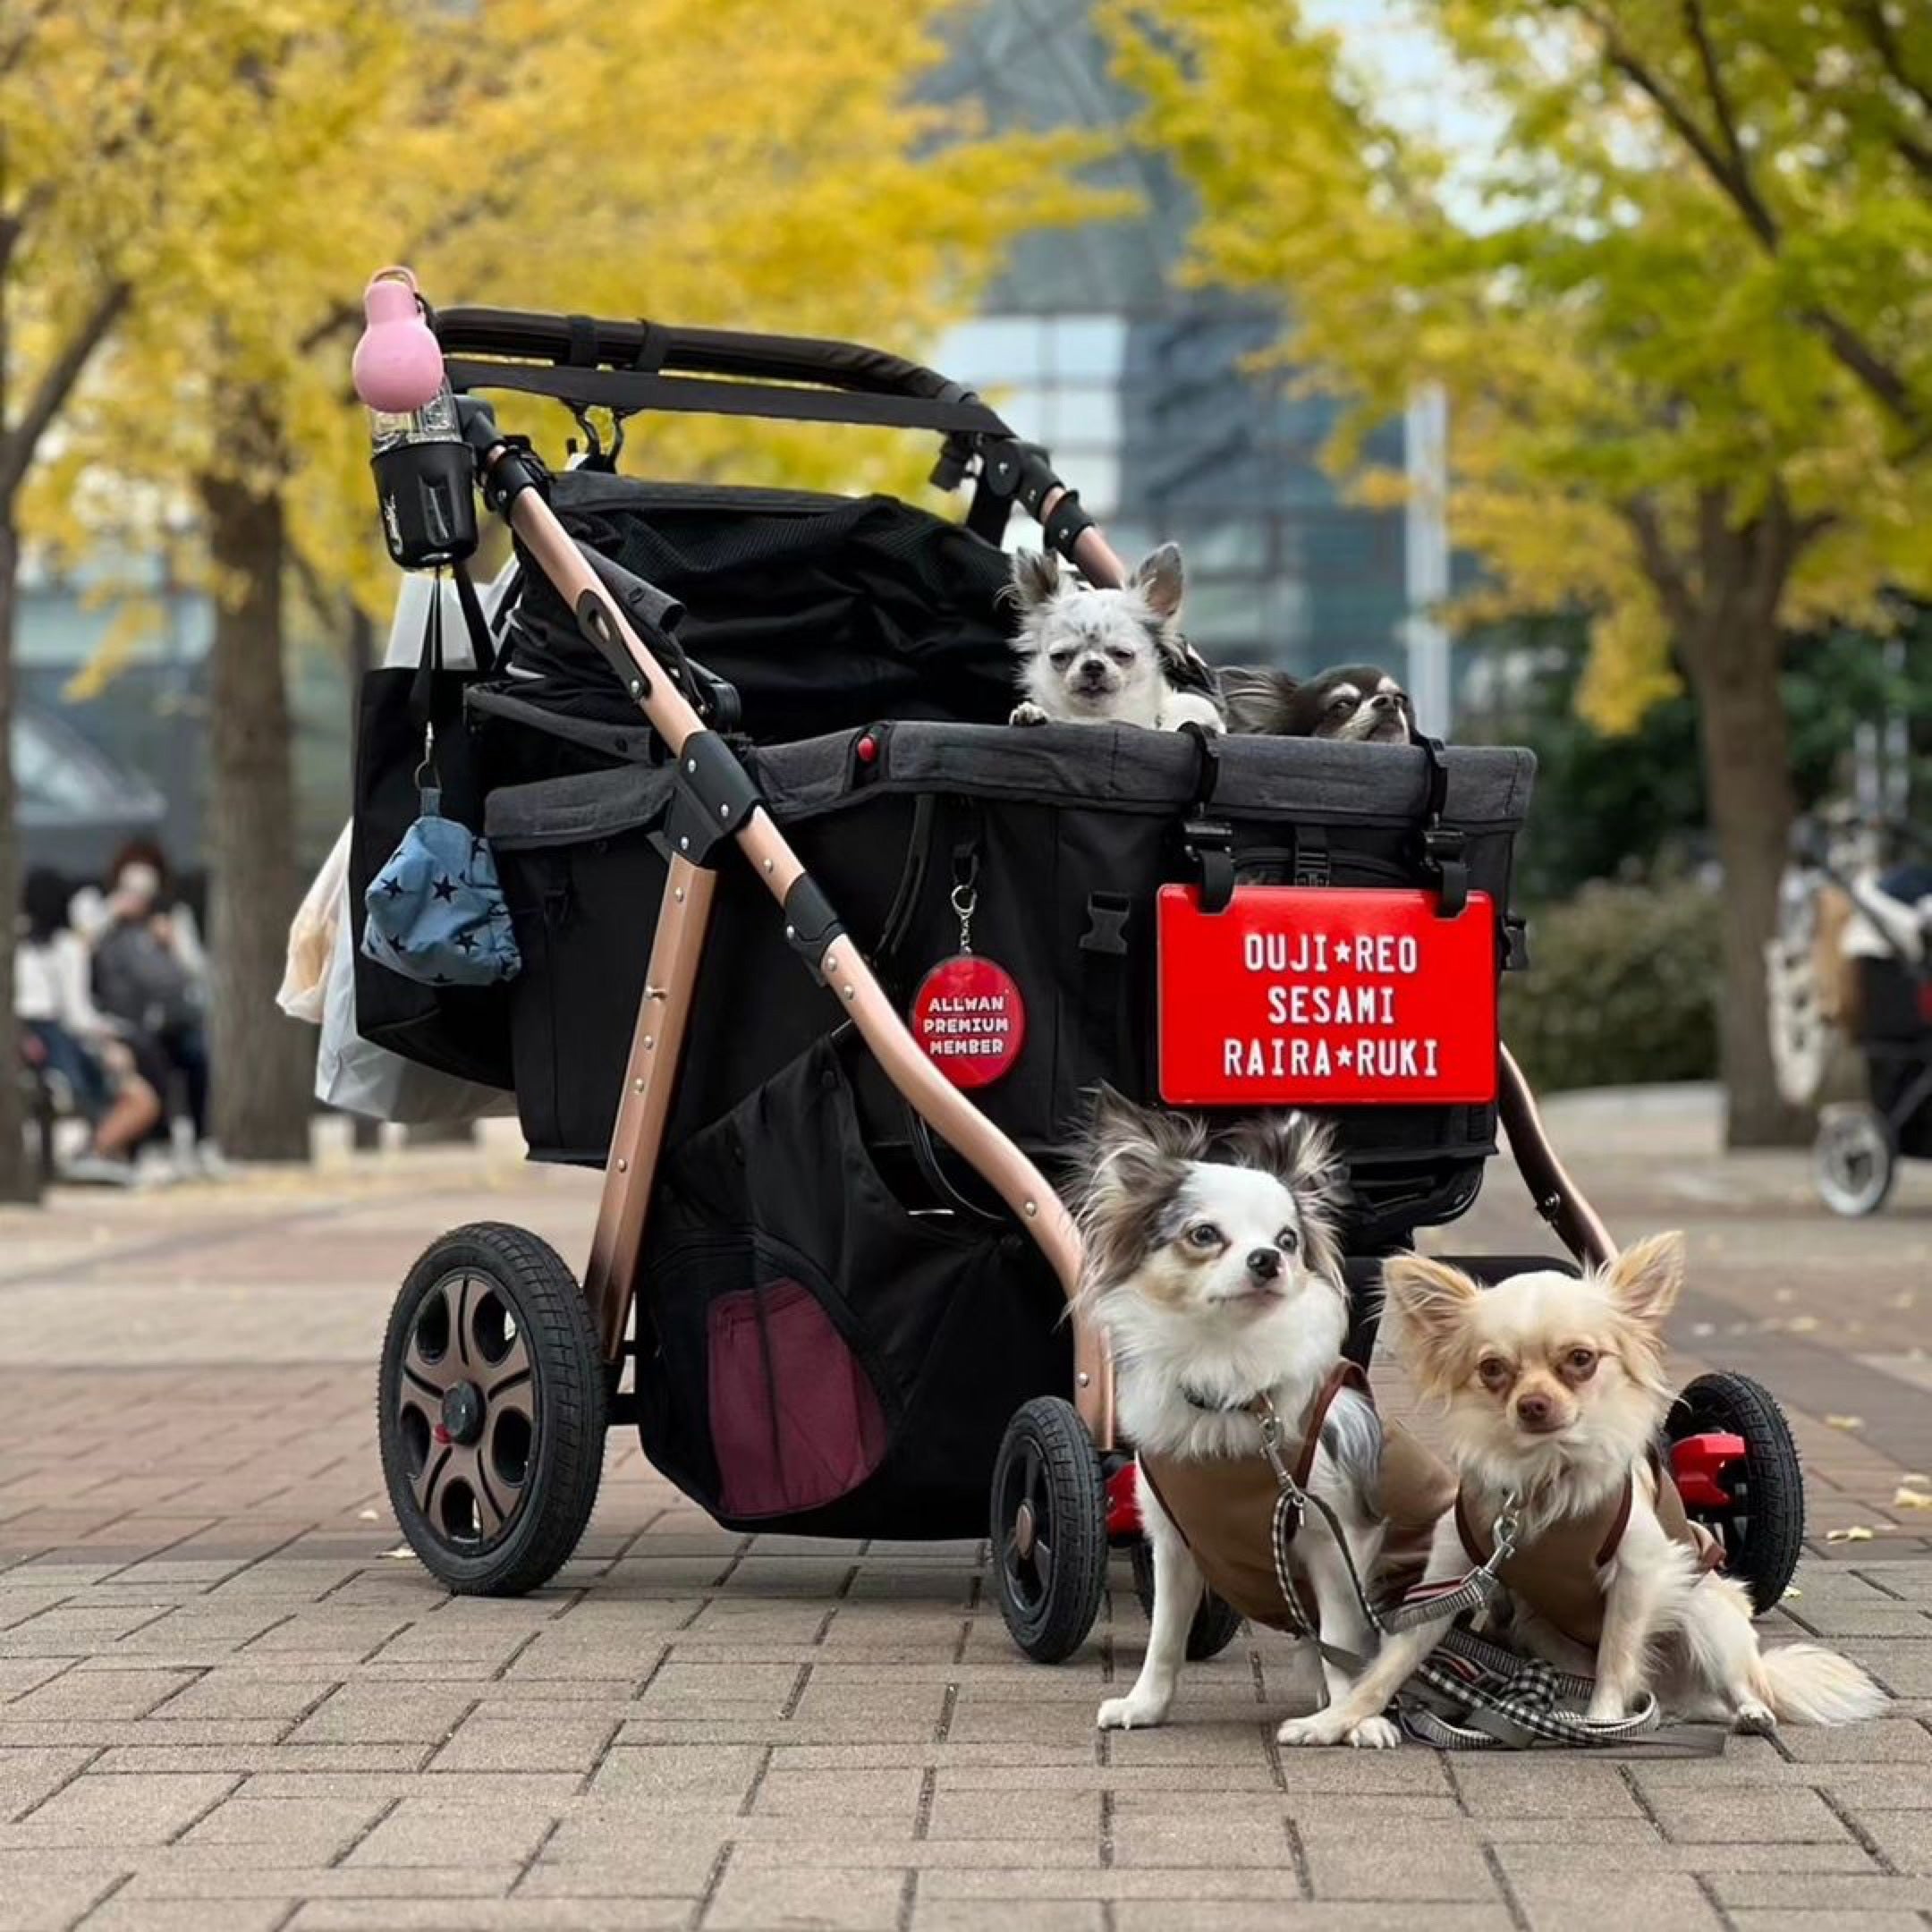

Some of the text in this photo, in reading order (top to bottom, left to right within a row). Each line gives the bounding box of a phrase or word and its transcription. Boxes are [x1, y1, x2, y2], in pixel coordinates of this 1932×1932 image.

[928, 996, 1004, 1013] ALLWAN
[1267, 986, 1394, 1024] SESAMI
[923, 1017, 1010, 1034] PREMIUM
[929, 1038, 1004, 1055] MEMBER
